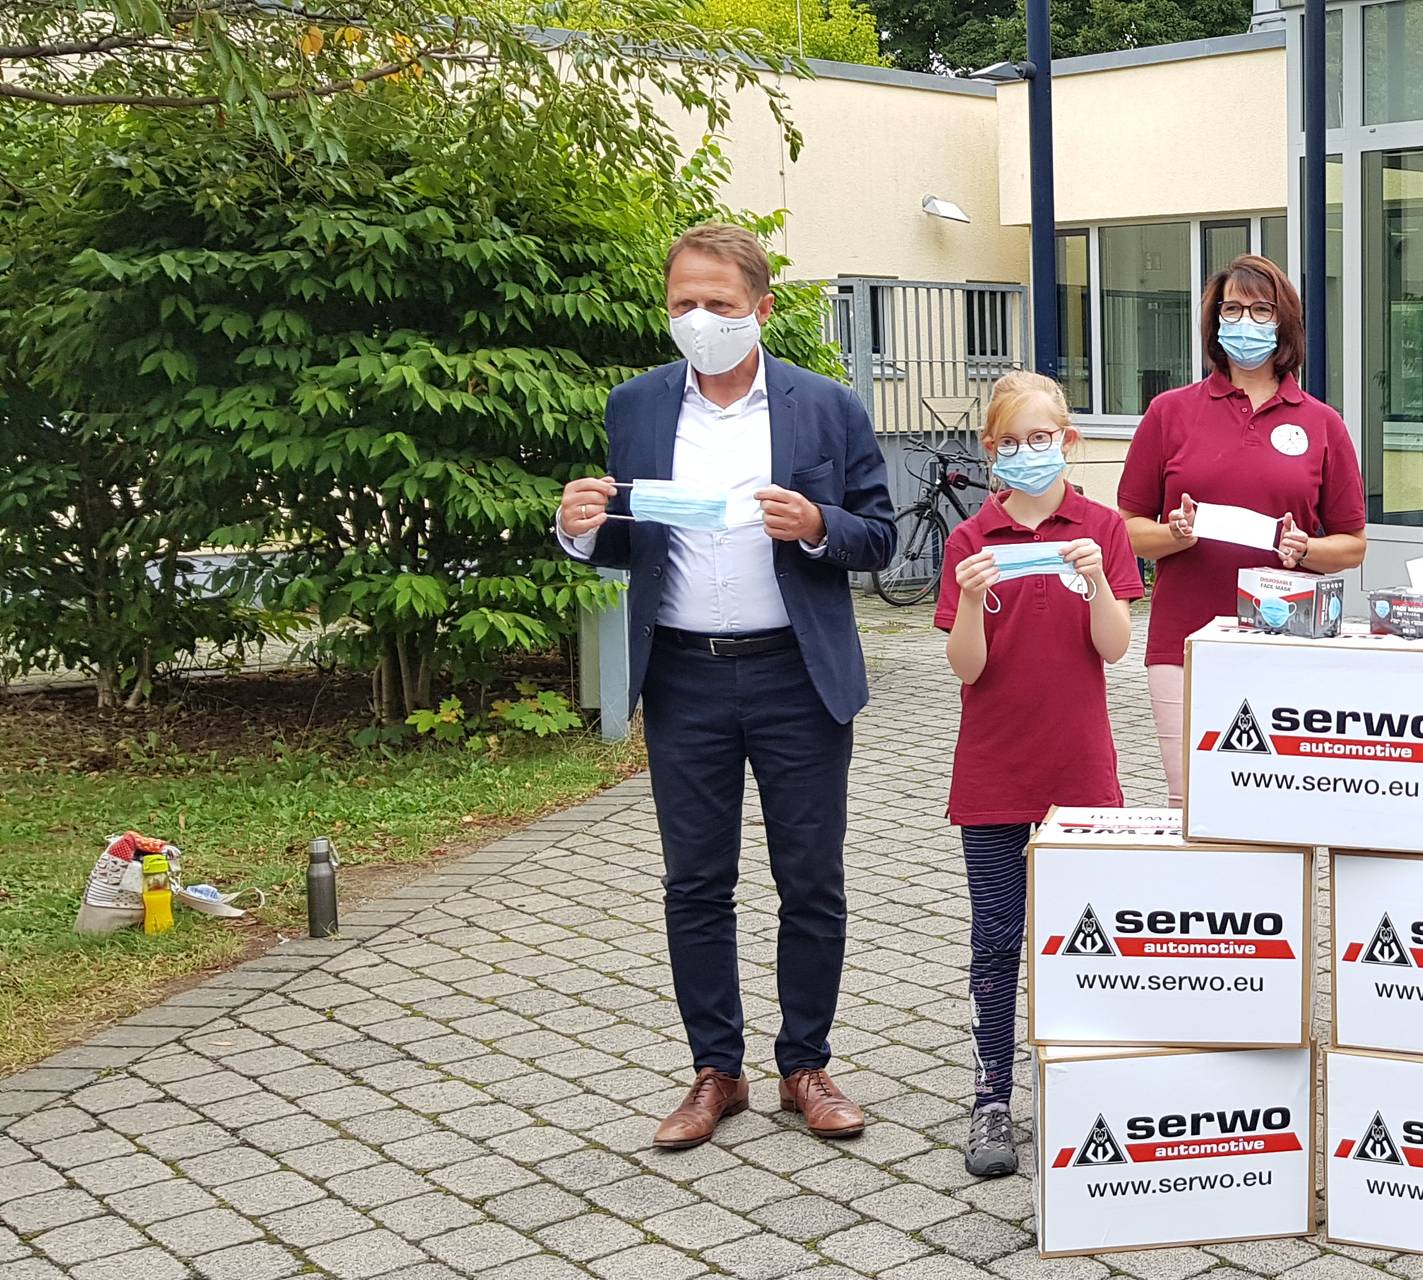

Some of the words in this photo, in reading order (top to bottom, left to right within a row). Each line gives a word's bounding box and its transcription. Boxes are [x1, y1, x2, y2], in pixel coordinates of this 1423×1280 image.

[1299, 740, 1413, 759] automotive
[1230, 770, 1420, 798] www.serwo.eu
[1114, 909, 1283, 937] serwo
[1143, 940, 1257, 956] automotive
[1075, 973, 1264, 992] www.serwo.eu
[1126, 1106, 1291, 1141] serwo
[1154, 1137, 1265, 1158] automotive
[1086, 1169, 1273, 1198] www.serwo.eu
